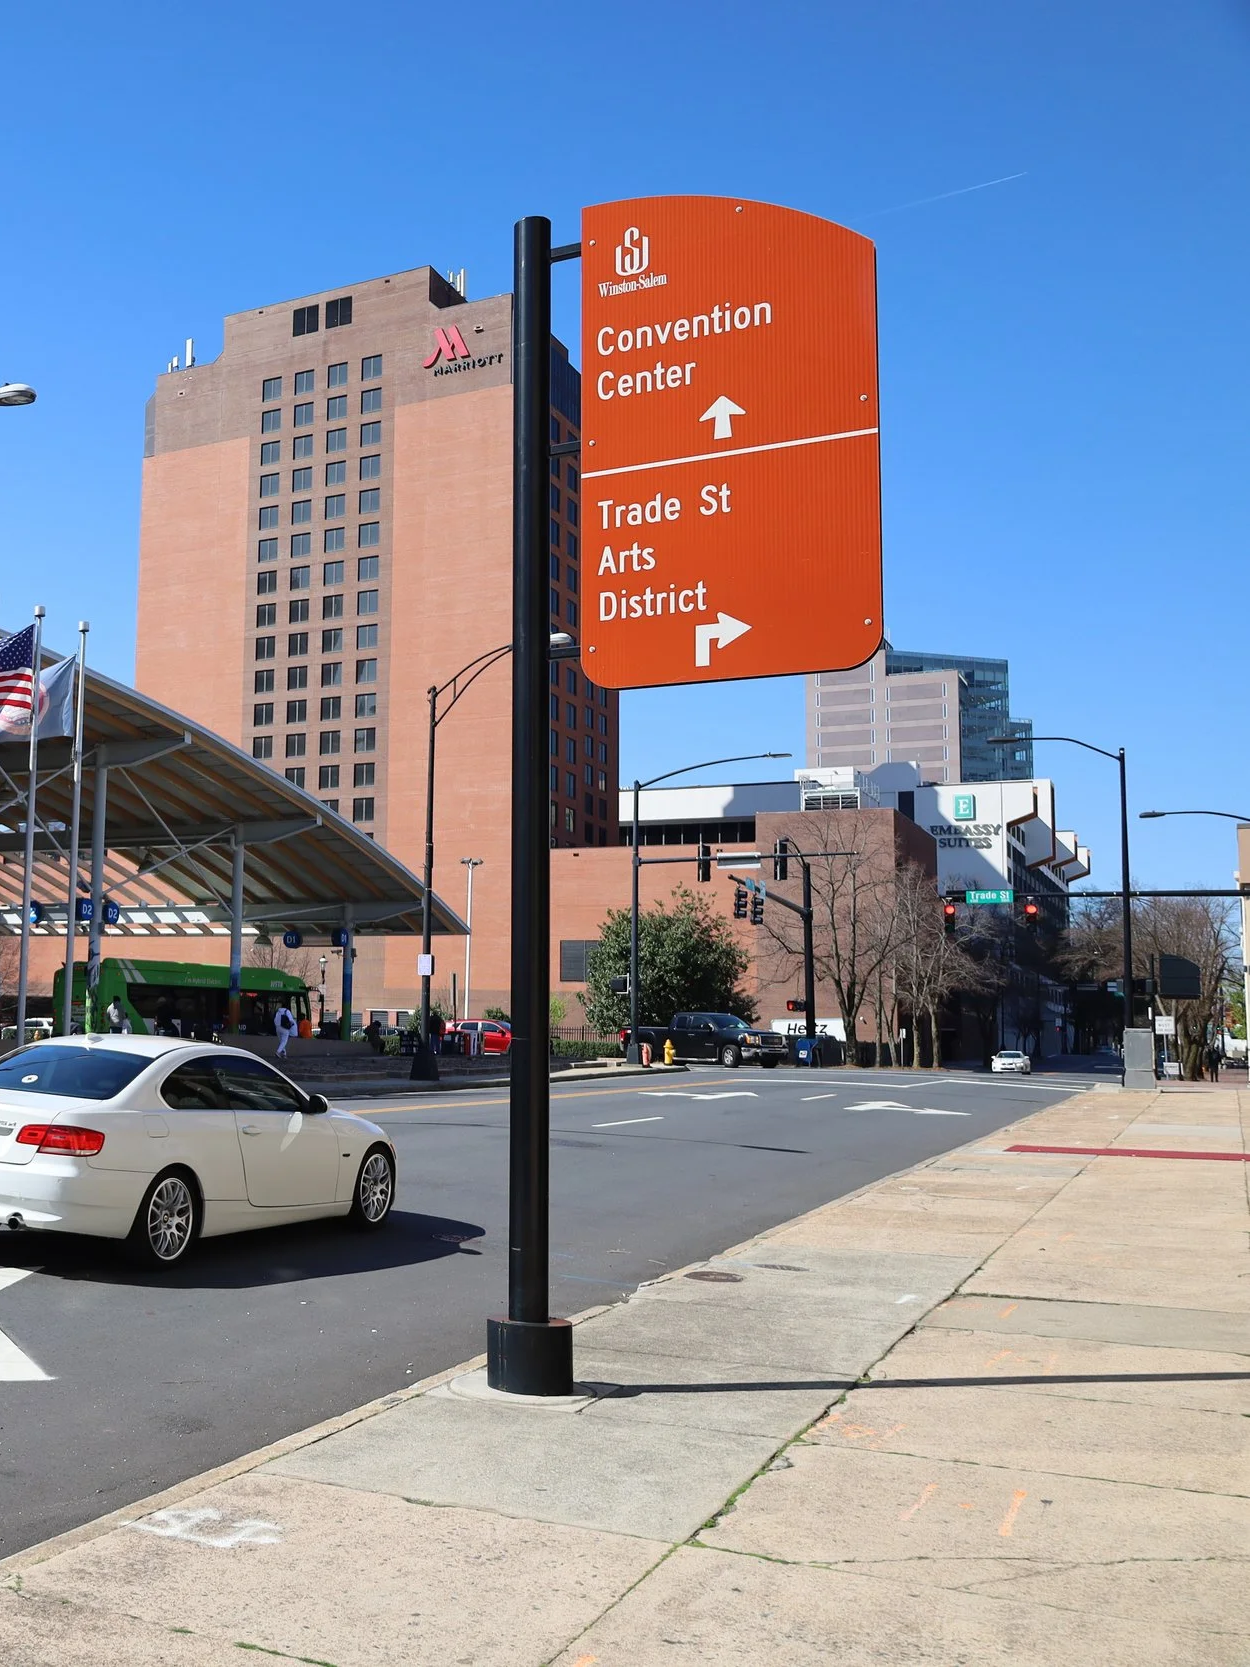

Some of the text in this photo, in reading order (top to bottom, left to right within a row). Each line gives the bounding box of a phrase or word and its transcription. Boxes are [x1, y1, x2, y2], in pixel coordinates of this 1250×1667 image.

[597, 271, 668, 298] Winston-Salem
[596, 300, 773, 357] Convention
[433, 353, 504, 377] MARRIOTT
[596, 360, 697, 401] Center
[597, 482, 732, 530] Trade St
[597, 541, 657, 576] Arts
[598, 580, 708, 622] District
[958, 799, 970, 815] E
[930, 824, 1002, 837] EMBASSY
[938, 837, 993, 850] SUITES
[970, 890, 1010, 900] Trade St
[82, 903, 93, 915] D2
[108, 908, 118, 919] D2
[286, 935, 296, 944] D1
[787, 1022, 828, 1034] Hetz
